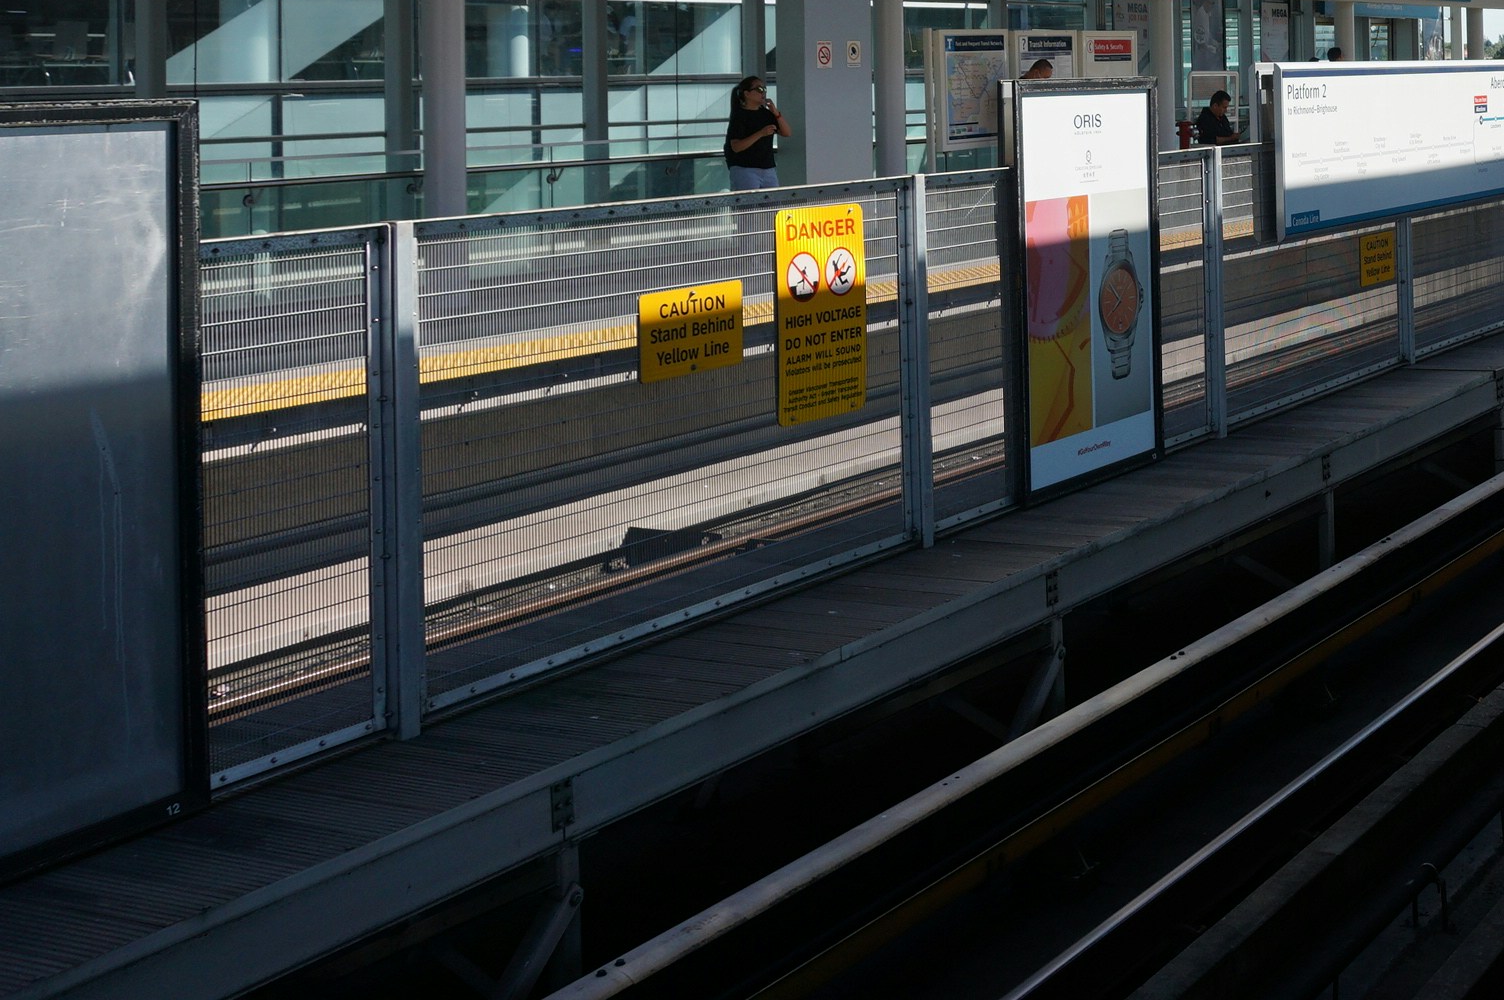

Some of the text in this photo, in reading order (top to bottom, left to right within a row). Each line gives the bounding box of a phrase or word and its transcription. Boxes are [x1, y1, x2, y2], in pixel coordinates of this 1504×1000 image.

[1128, 3, 1148, 13] MEGA
[1271, 8, 1288, 17] MEGA
[1029, 39, 1067, 48] Transit Information
[1287, 83, 1327, 100] Platform 2
[1287, 107, 1292, 115] to
[1073, 113, 1102, 129] ORIS
[1293, 214, 1319, 227] Canada Line
[786, 218, 855, 242] DANGER
[1366, 238, 1389, 251] CAUTION
[1364, 250, 1392, 265] Stand Behind
[1366, 264, 1391, 278] Yellow Line
[659, 294, 725, 319] CAUTION
[785, 305, 862, 330] HIGH VOLTAGE
[650, 314, 735, 344] Stand Behind
[785, 326, 862, 351] DO NOT ENTER
[656, 341, 730, 366] Yellow Line
[786, 343, 861, 366] ALARM WILL SOUND
[785, 365, 810, 377] Violators
[824, 361, 831, 370] be
[832, 355, 862, 368] prosecuted
